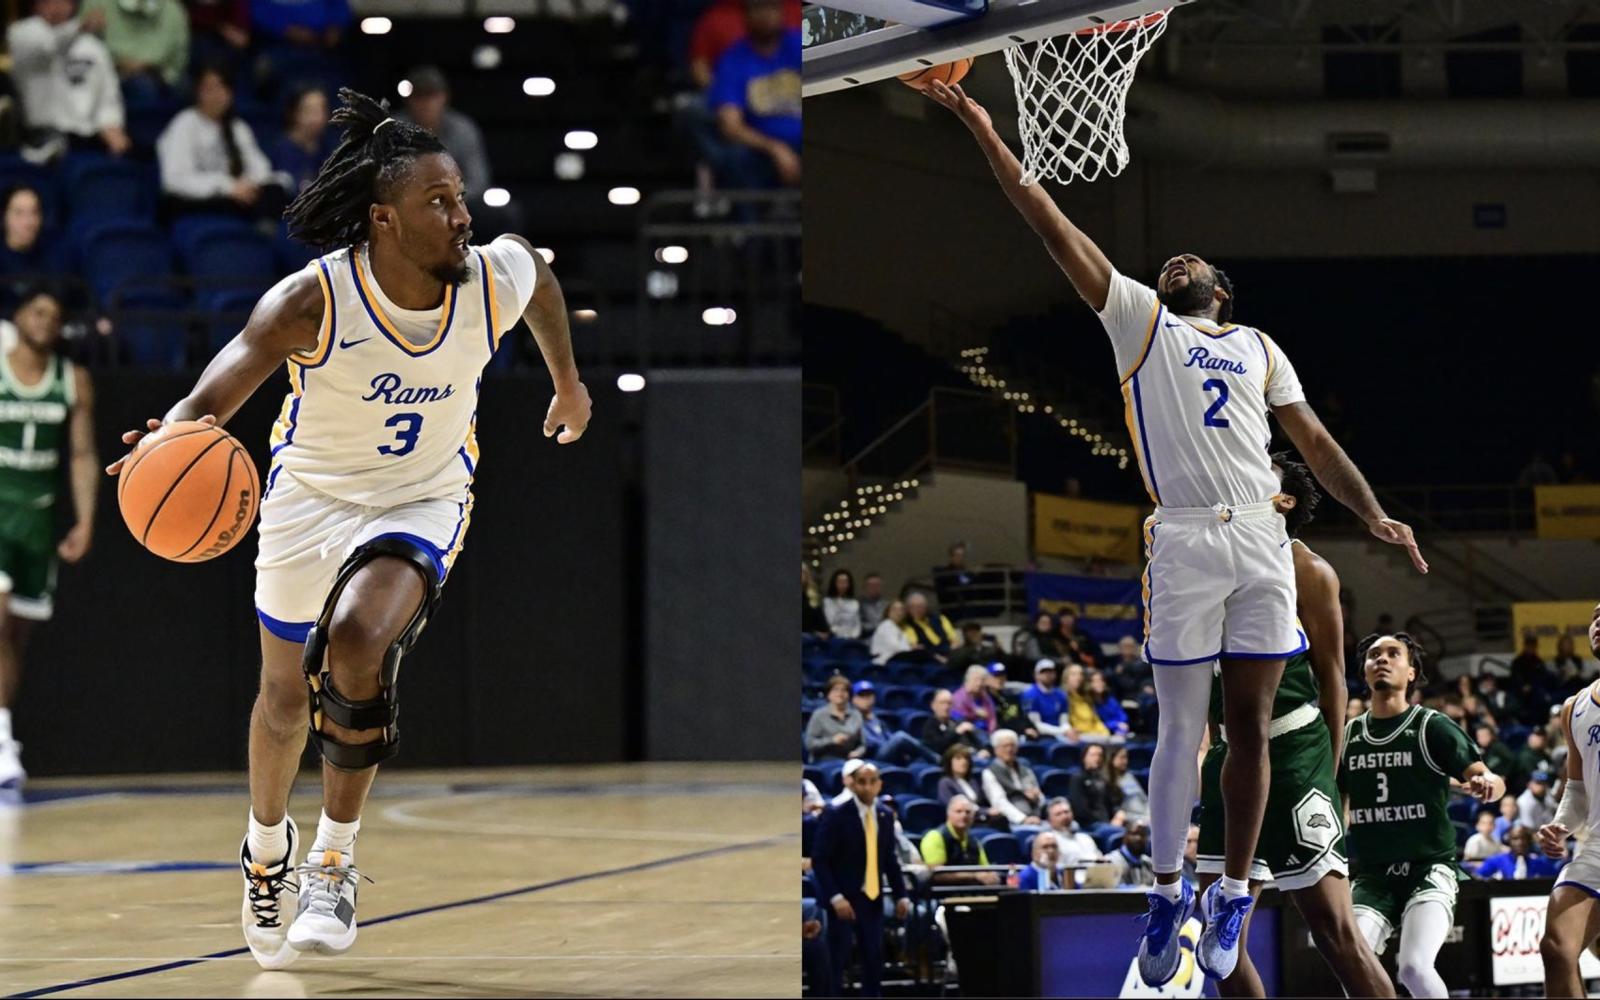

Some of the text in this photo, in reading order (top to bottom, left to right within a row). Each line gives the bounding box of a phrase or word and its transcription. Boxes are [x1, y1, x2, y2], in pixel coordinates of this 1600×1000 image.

[1183, 346, 1248, 375] Rams
[361, 372, 456, 404] Rams
[1202, 378, 1230, 428] 2
[376, 412, 424, 456] 3
[1348, 751, 1413, 771] EASTERN
[1375, 772, 1389, 803] 3
[1374, 803, 1427, 822] MEXICO
